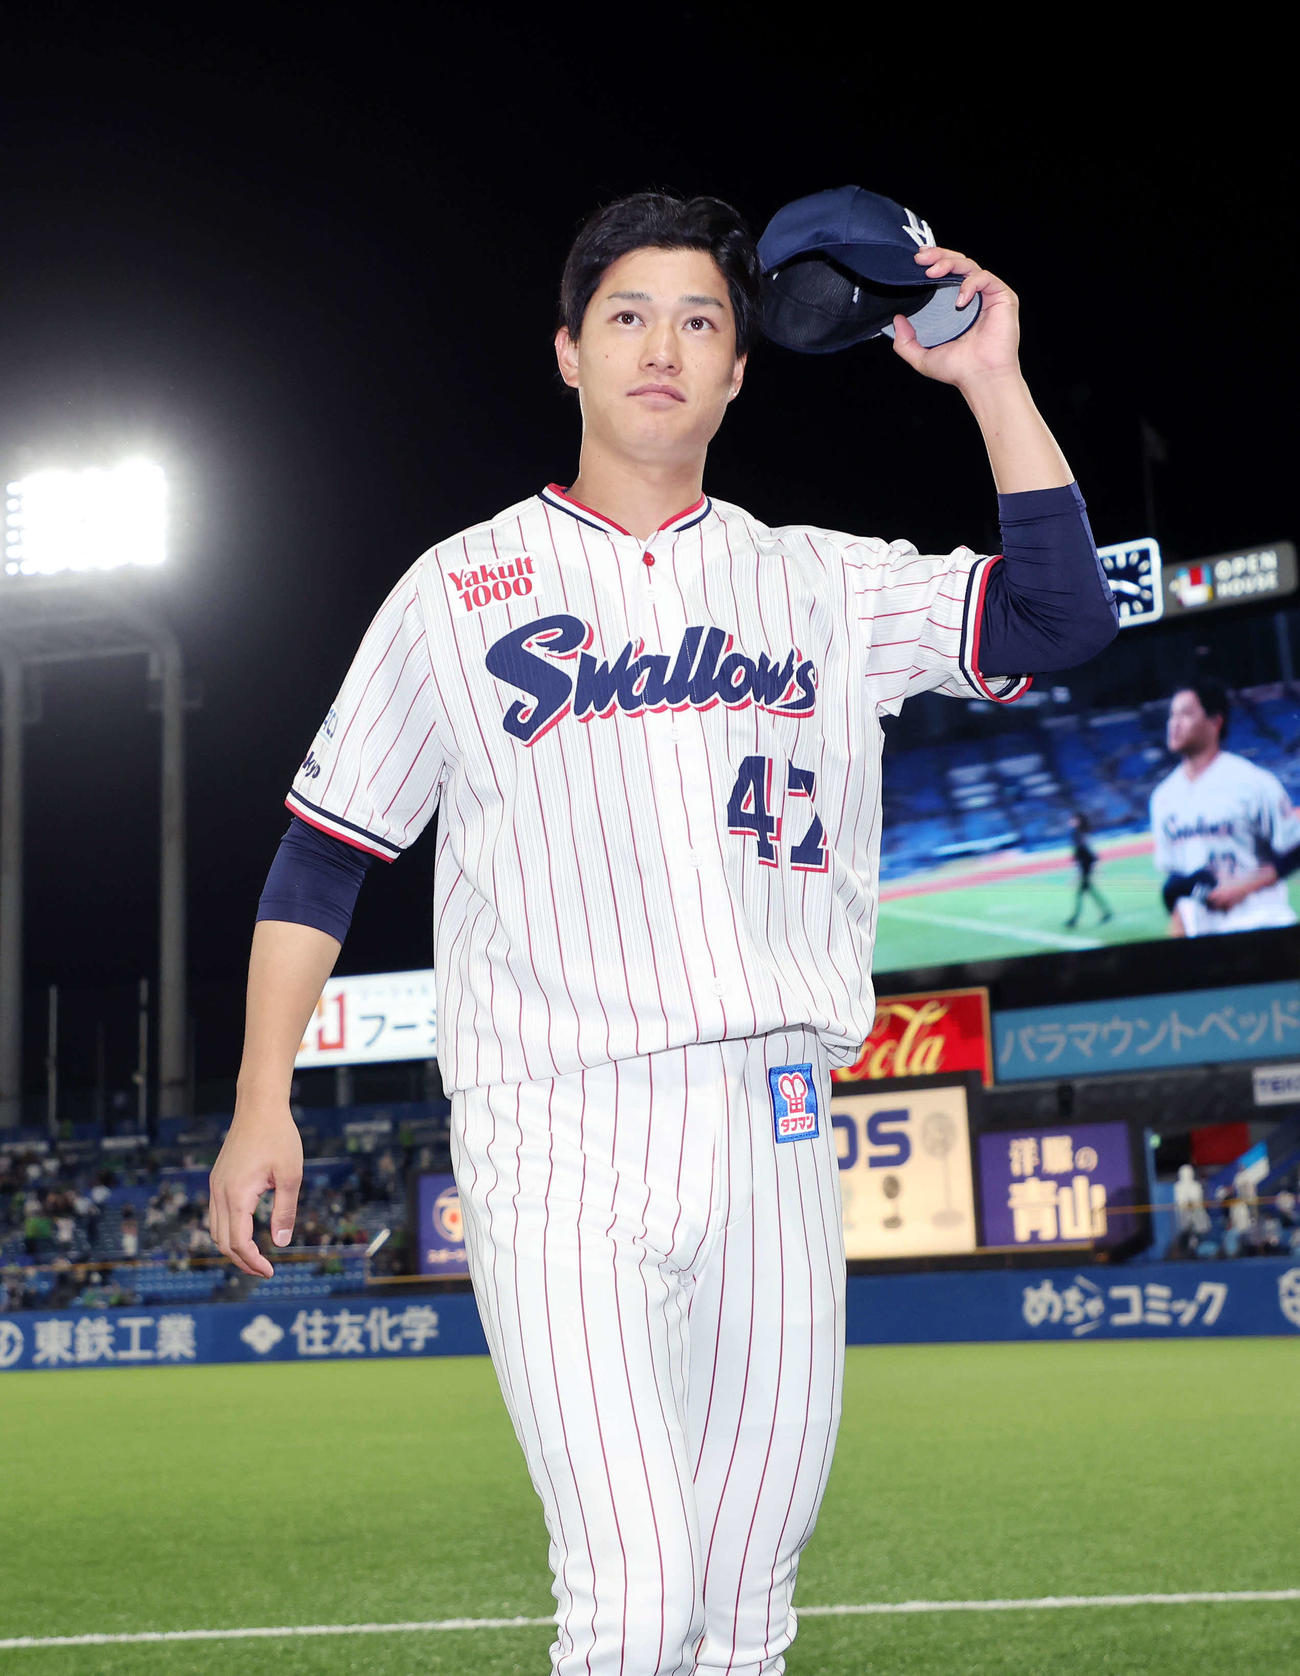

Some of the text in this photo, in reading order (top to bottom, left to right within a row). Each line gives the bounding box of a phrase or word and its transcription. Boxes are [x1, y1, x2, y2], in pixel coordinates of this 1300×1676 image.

[448, 556, 536, 591] Yakult
[1214, 550, 1277, 582] OPEN
[459, 577, 532, 612] 1000
[485, 614, 818, 748] Swallows
[727, 756, 829, 873] 47
[1000, 1000, 1300, 1064] パラマウントベッド
[781, 1116, 814, 1133] タフマン
[1008, 1175, 1108, 1243] 青山
[290, 1304, 440, 1355] 住友化学
[1022, 1277, 1229, 1330] めちゃコミック
[32, 1313, 197, 1365] 東鉄工業
